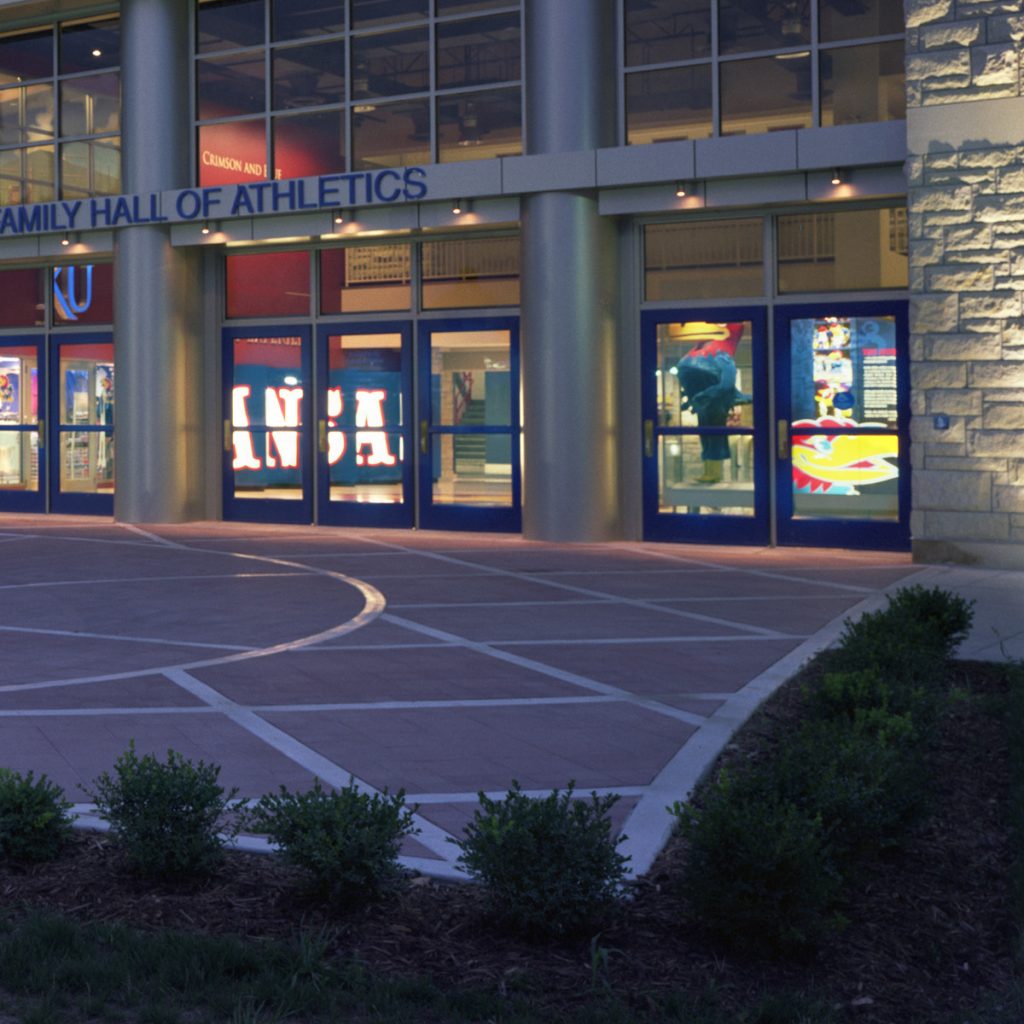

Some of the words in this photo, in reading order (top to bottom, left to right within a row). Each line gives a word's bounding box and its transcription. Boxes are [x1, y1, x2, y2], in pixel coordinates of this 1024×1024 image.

[202, 150, 243, 172] CRIMSON
[244, 162, 263, 177] AND
[90, 193, 168, 228] HALL
[176, 187, 222, 220] OF
[230, 167, 428, 216] ATHLETICS
